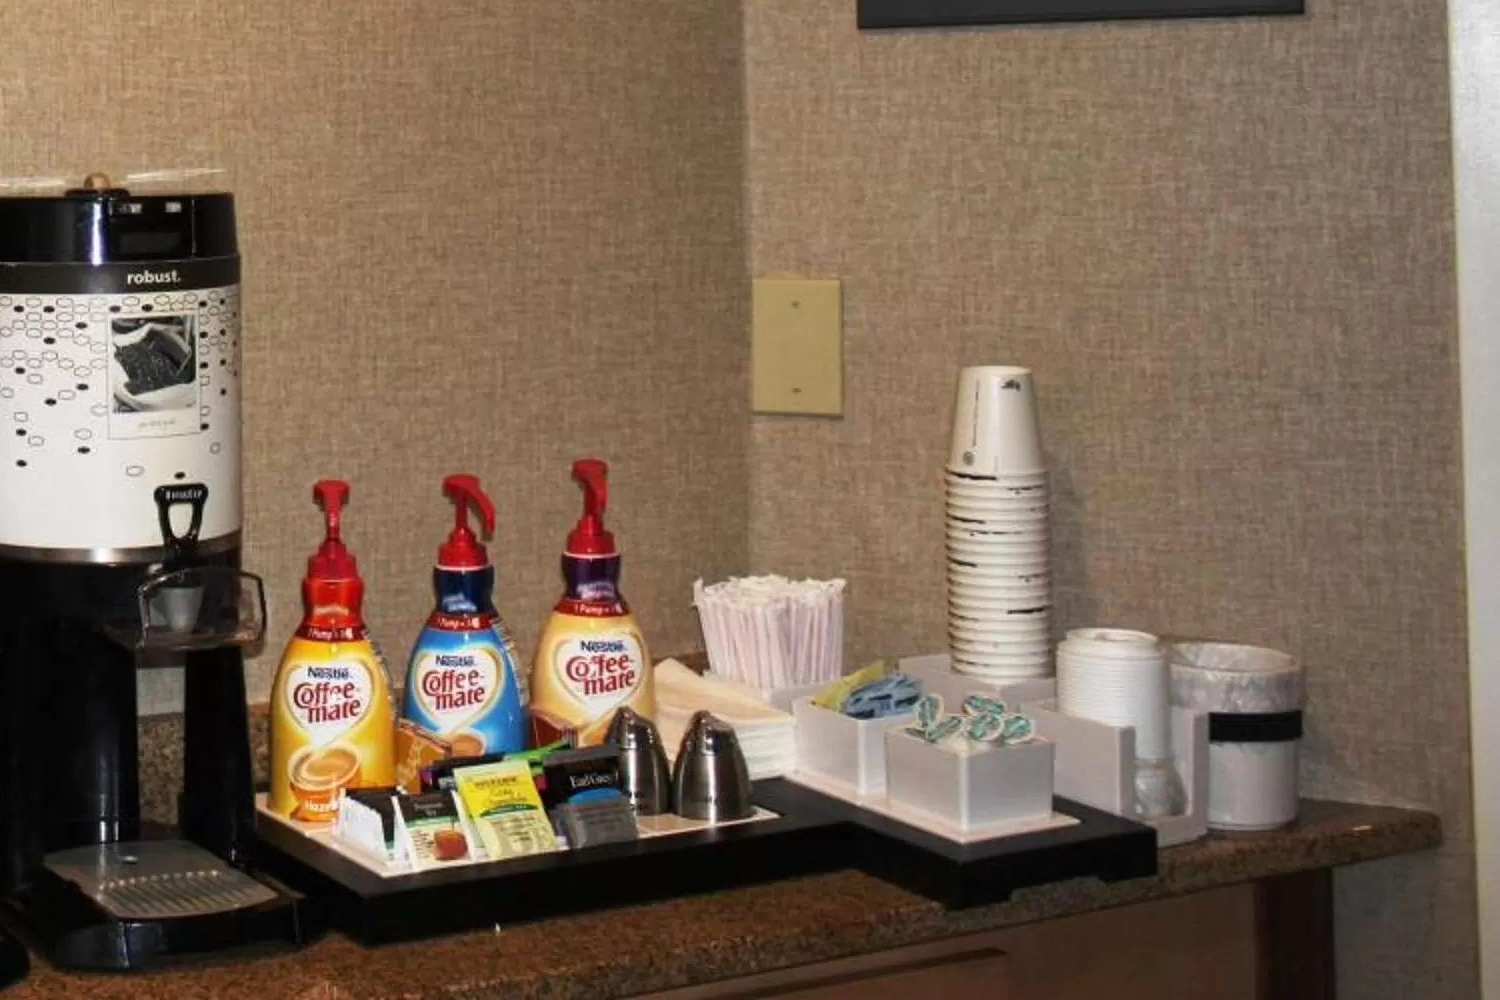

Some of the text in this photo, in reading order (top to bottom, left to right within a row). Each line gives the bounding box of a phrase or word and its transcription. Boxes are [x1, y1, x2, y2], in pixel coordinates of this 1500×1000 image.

[126, 268, 181, 285] robust.
[583, 669, 635, 696] mate
[435, 686, 485, 711] mate
[308, 699, 361, 724] mate
